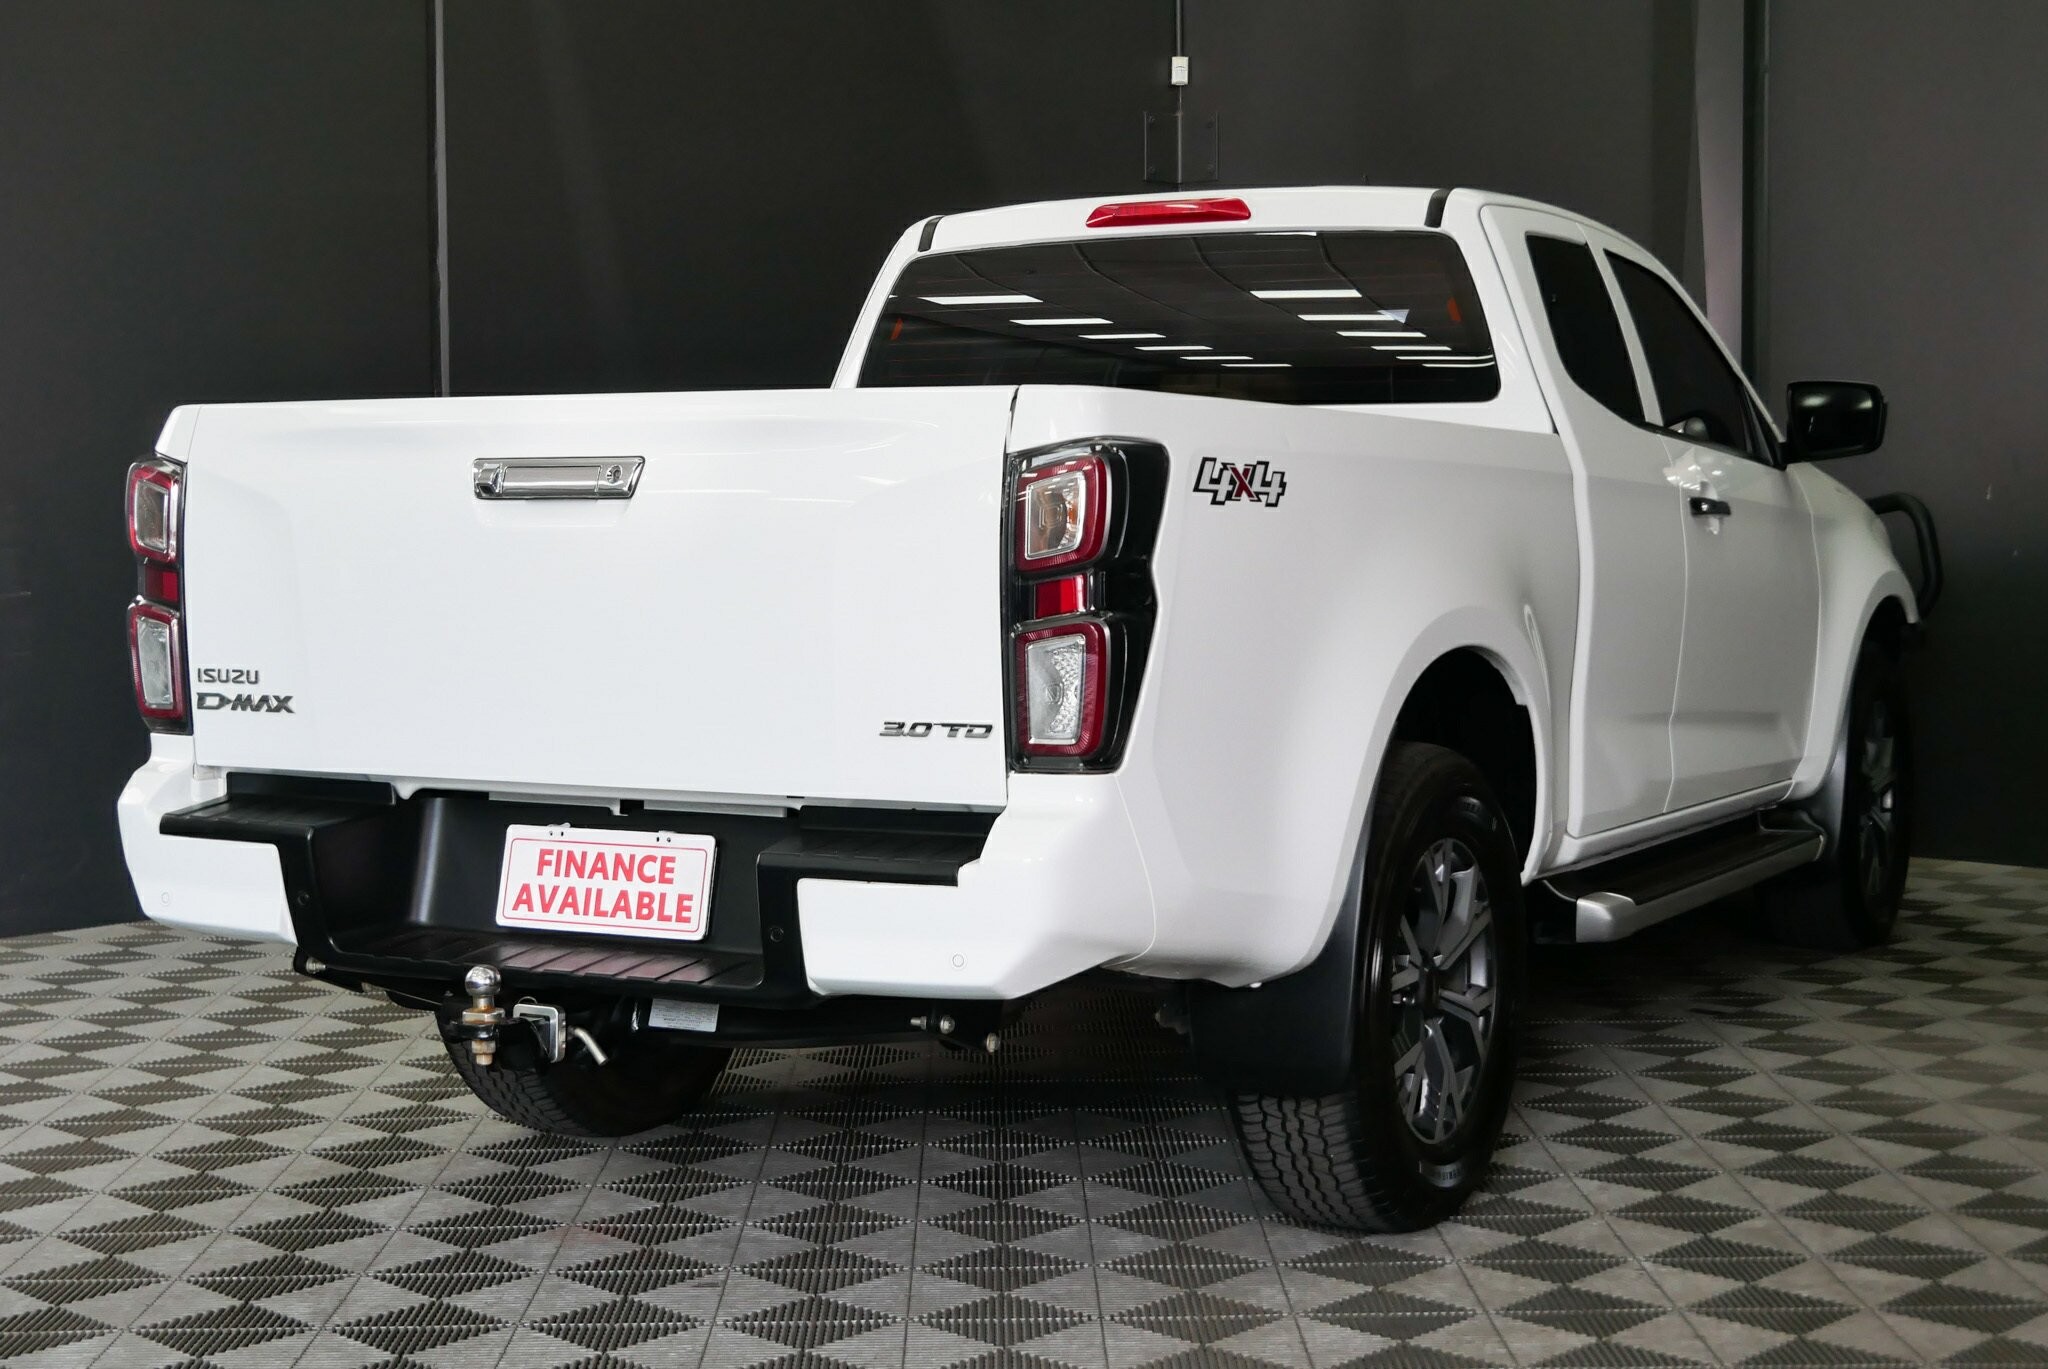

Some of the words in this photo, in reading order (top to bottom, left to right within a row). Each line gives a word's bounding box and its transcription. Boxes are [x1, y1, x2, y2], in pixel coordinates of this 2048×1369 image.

[197, 667, 259, 684] ISUZU
[196, 692, 295, 713] D-MAX
[879, 721, 933, 737] 3.0
[934, 722, 993, 739] TD
[536, 848, 677, 885] FINANCE
[511, 882, 694, 924] AVAILABLE
